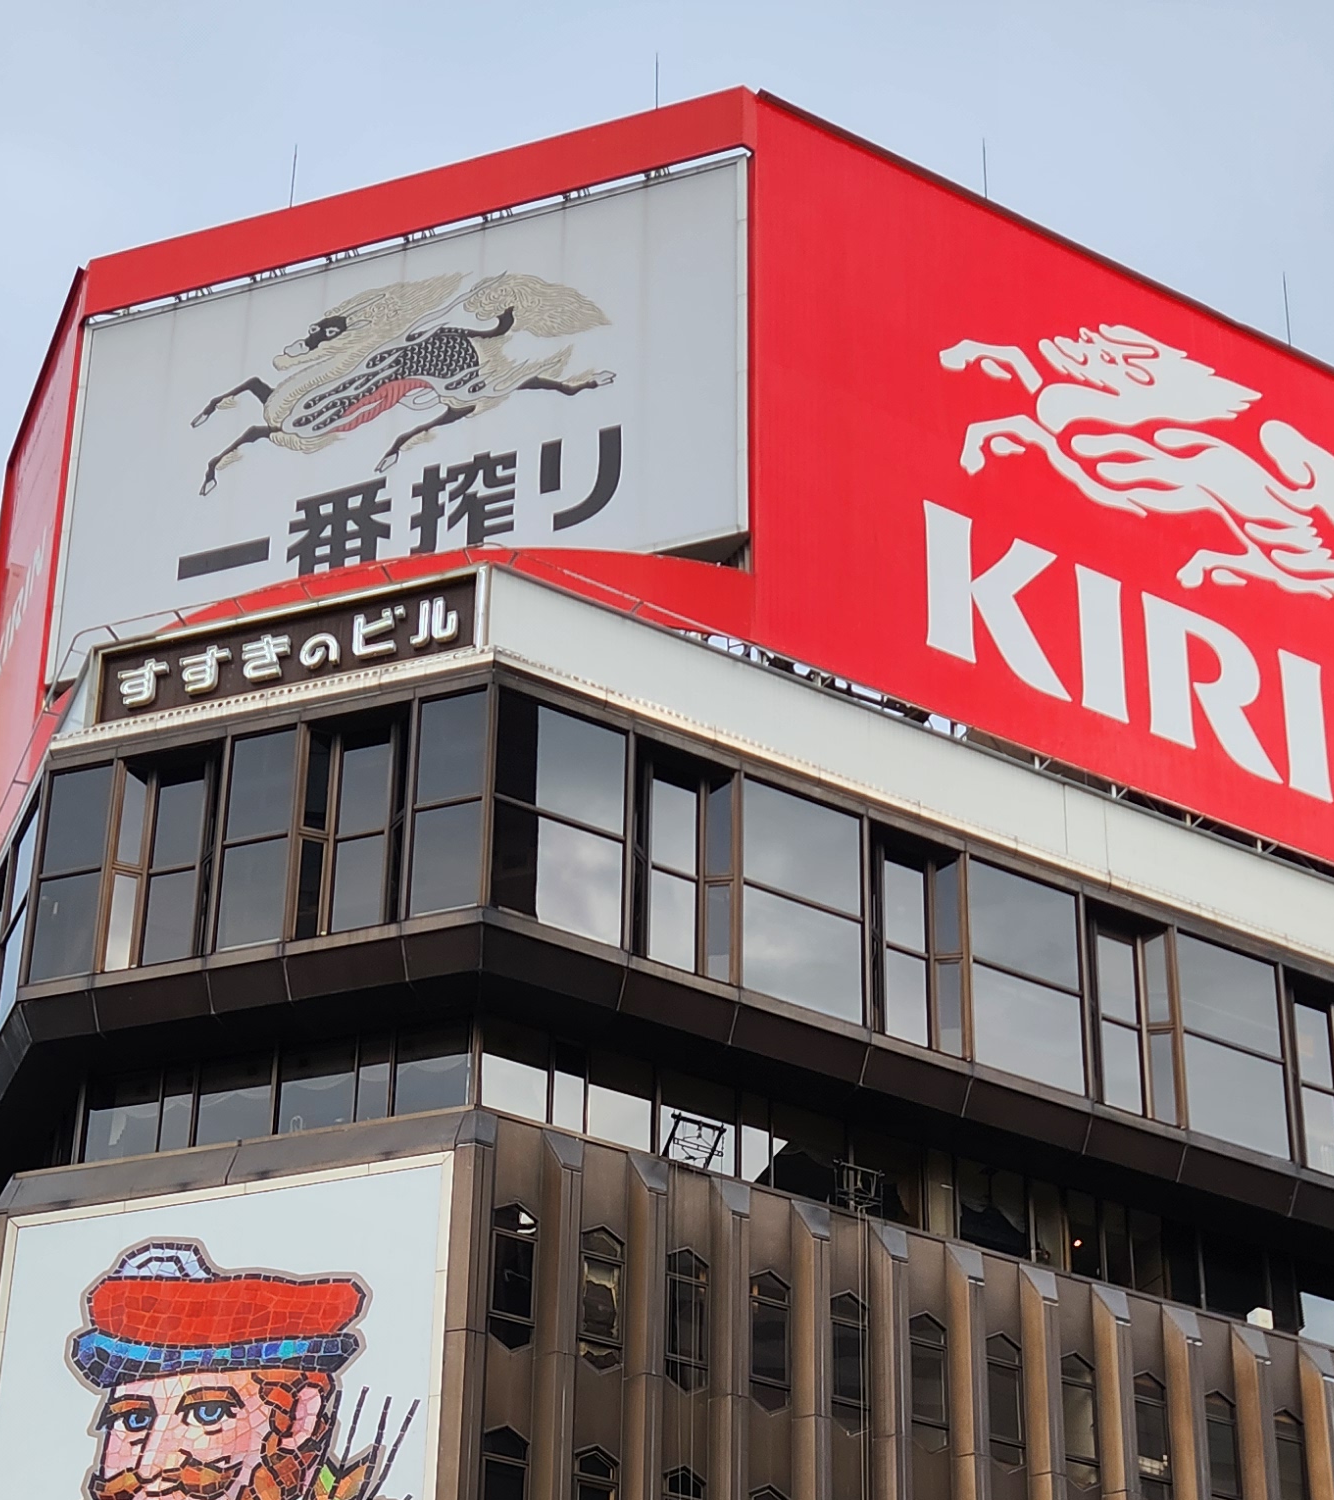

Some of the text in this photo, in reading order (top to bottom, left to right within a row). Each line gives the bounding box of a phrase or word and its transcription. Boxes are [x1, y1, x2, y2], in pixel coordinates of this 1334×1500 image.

[177, 425, 622, 582] 一番搾り
[117, 596, 458, 707] すすきのビル
